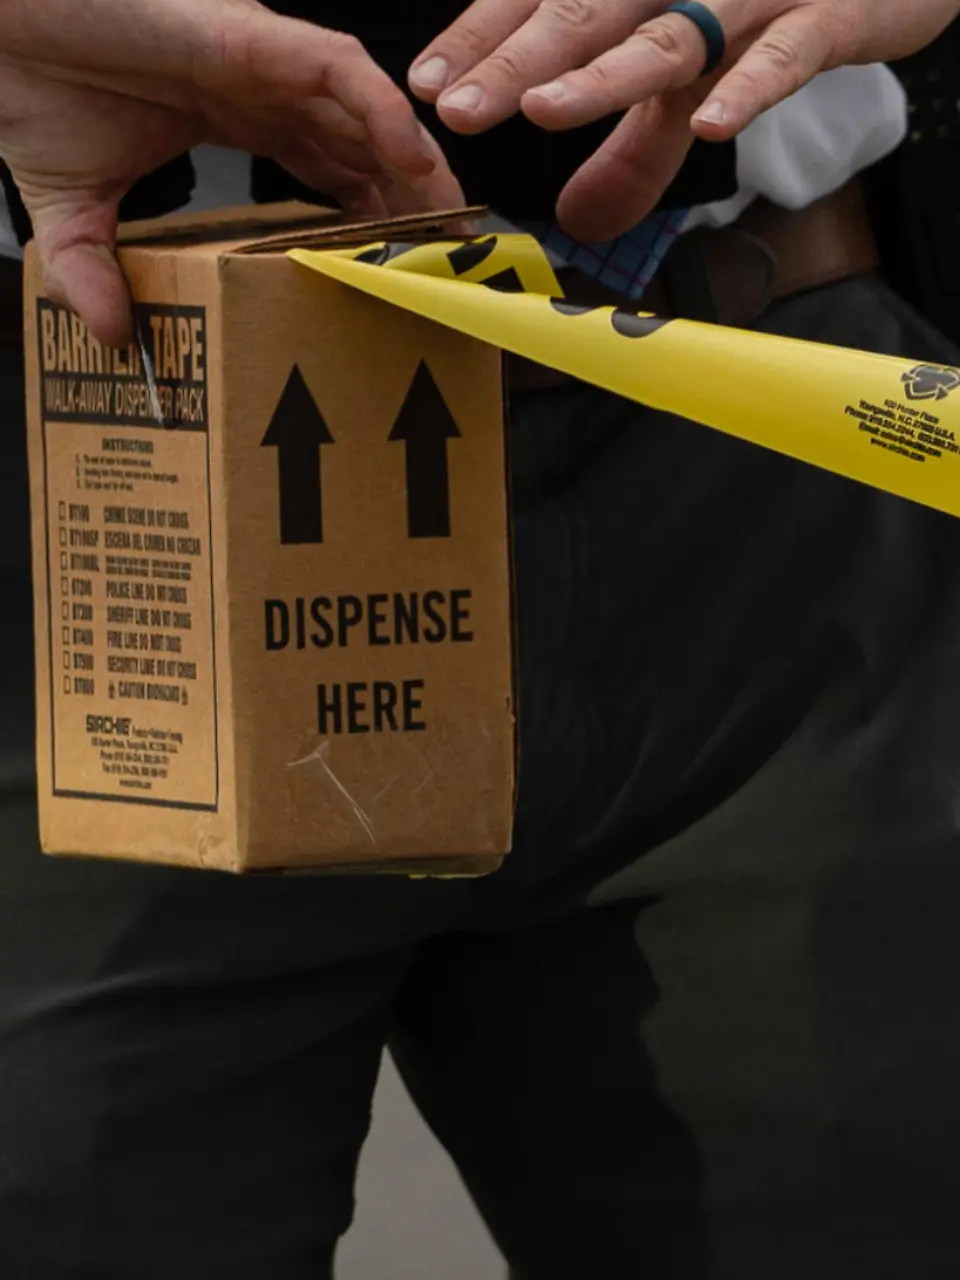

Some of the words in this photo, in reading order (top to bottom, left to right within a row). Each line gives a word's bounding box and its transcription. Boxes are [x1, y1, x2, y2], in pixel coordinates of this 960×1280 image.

[150, 316, 203, 381] TAPE
[45, 378, 112, 412] WALK-AWAY
[115, 382, 173, 419] DISPENER
[175, 387, 204, 422] PACK
[264, 589, 474, 651] DISPENSE
[317, 679, 426, 735] HERE
